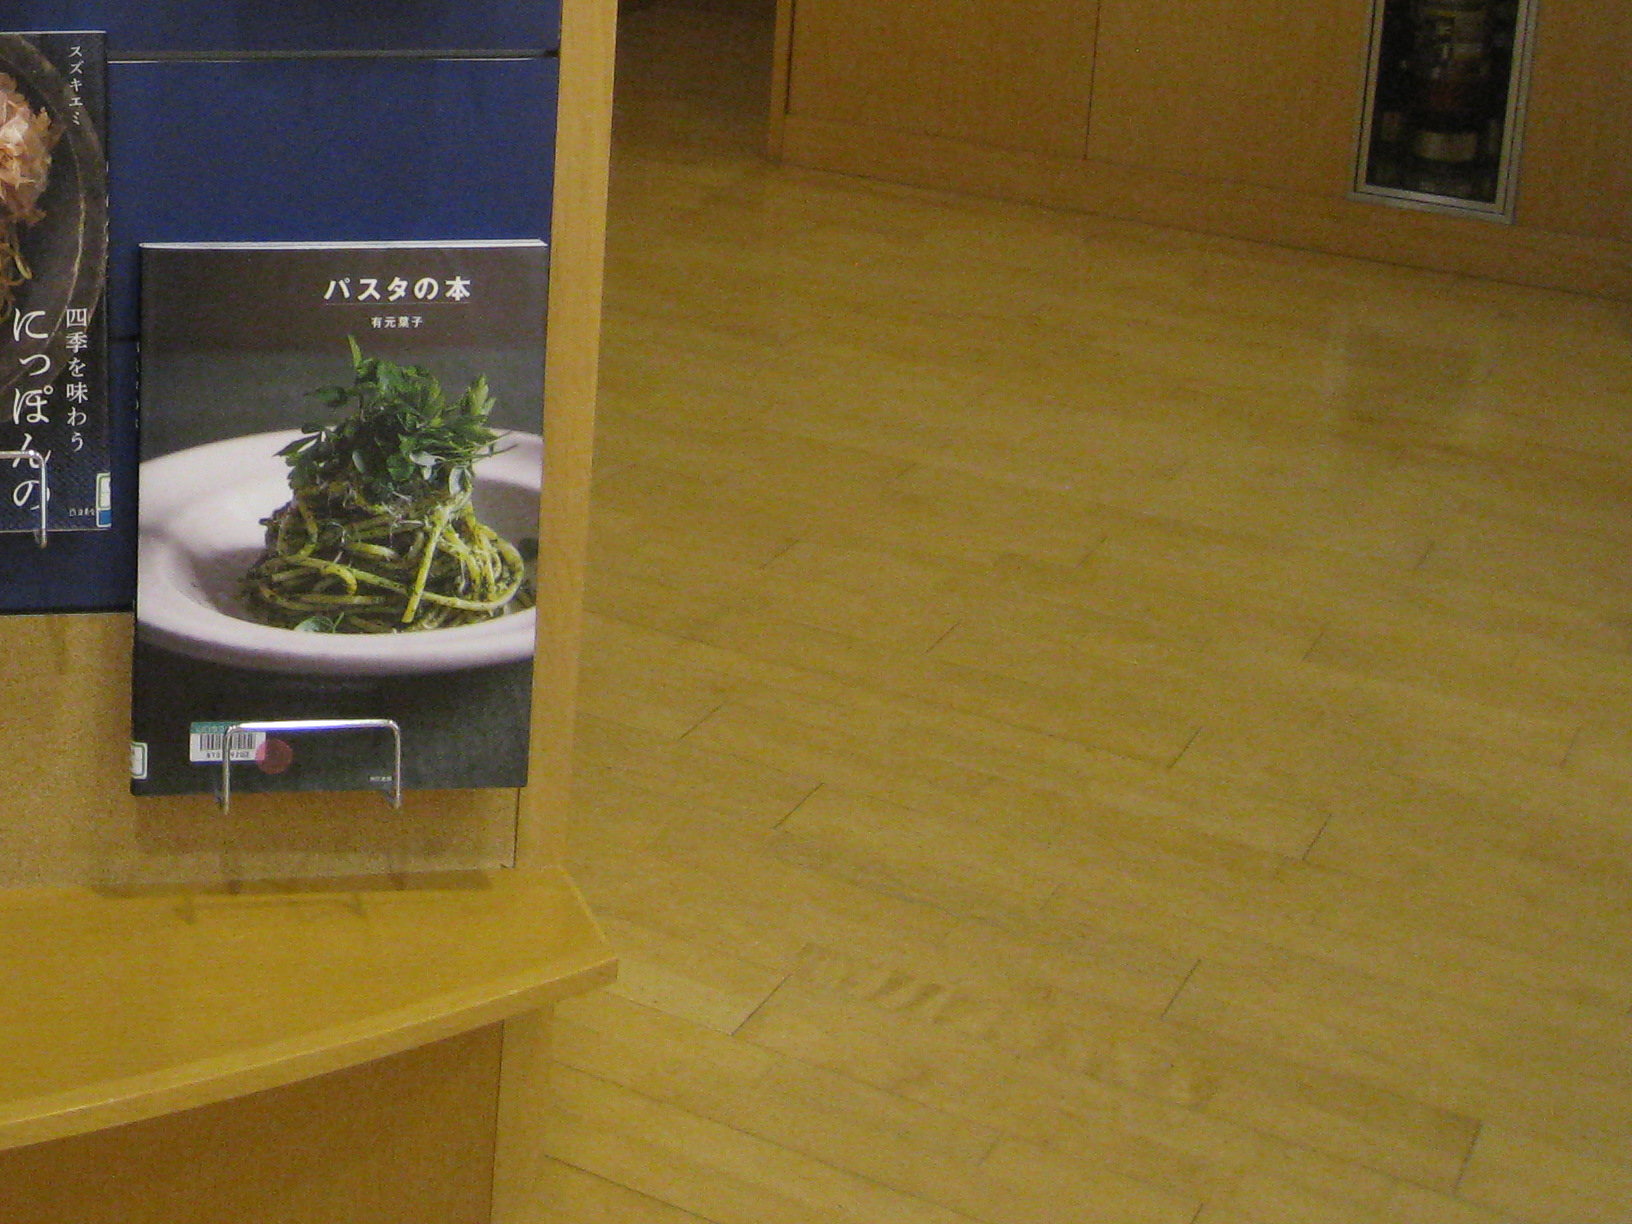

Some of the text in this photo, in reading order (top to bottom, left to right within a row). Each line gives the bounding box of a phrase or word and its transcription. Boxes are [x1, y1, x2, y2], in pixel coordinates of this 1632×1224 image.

[68, 46, 84, 125] スズキエミ
[323, 276, 471, 302] パスタの本
[371, 316, 424, 328] 有元葉子
[12, 307, 53, 511] にっぽんの
[65, 308, 89, 453] 四季を味わう
